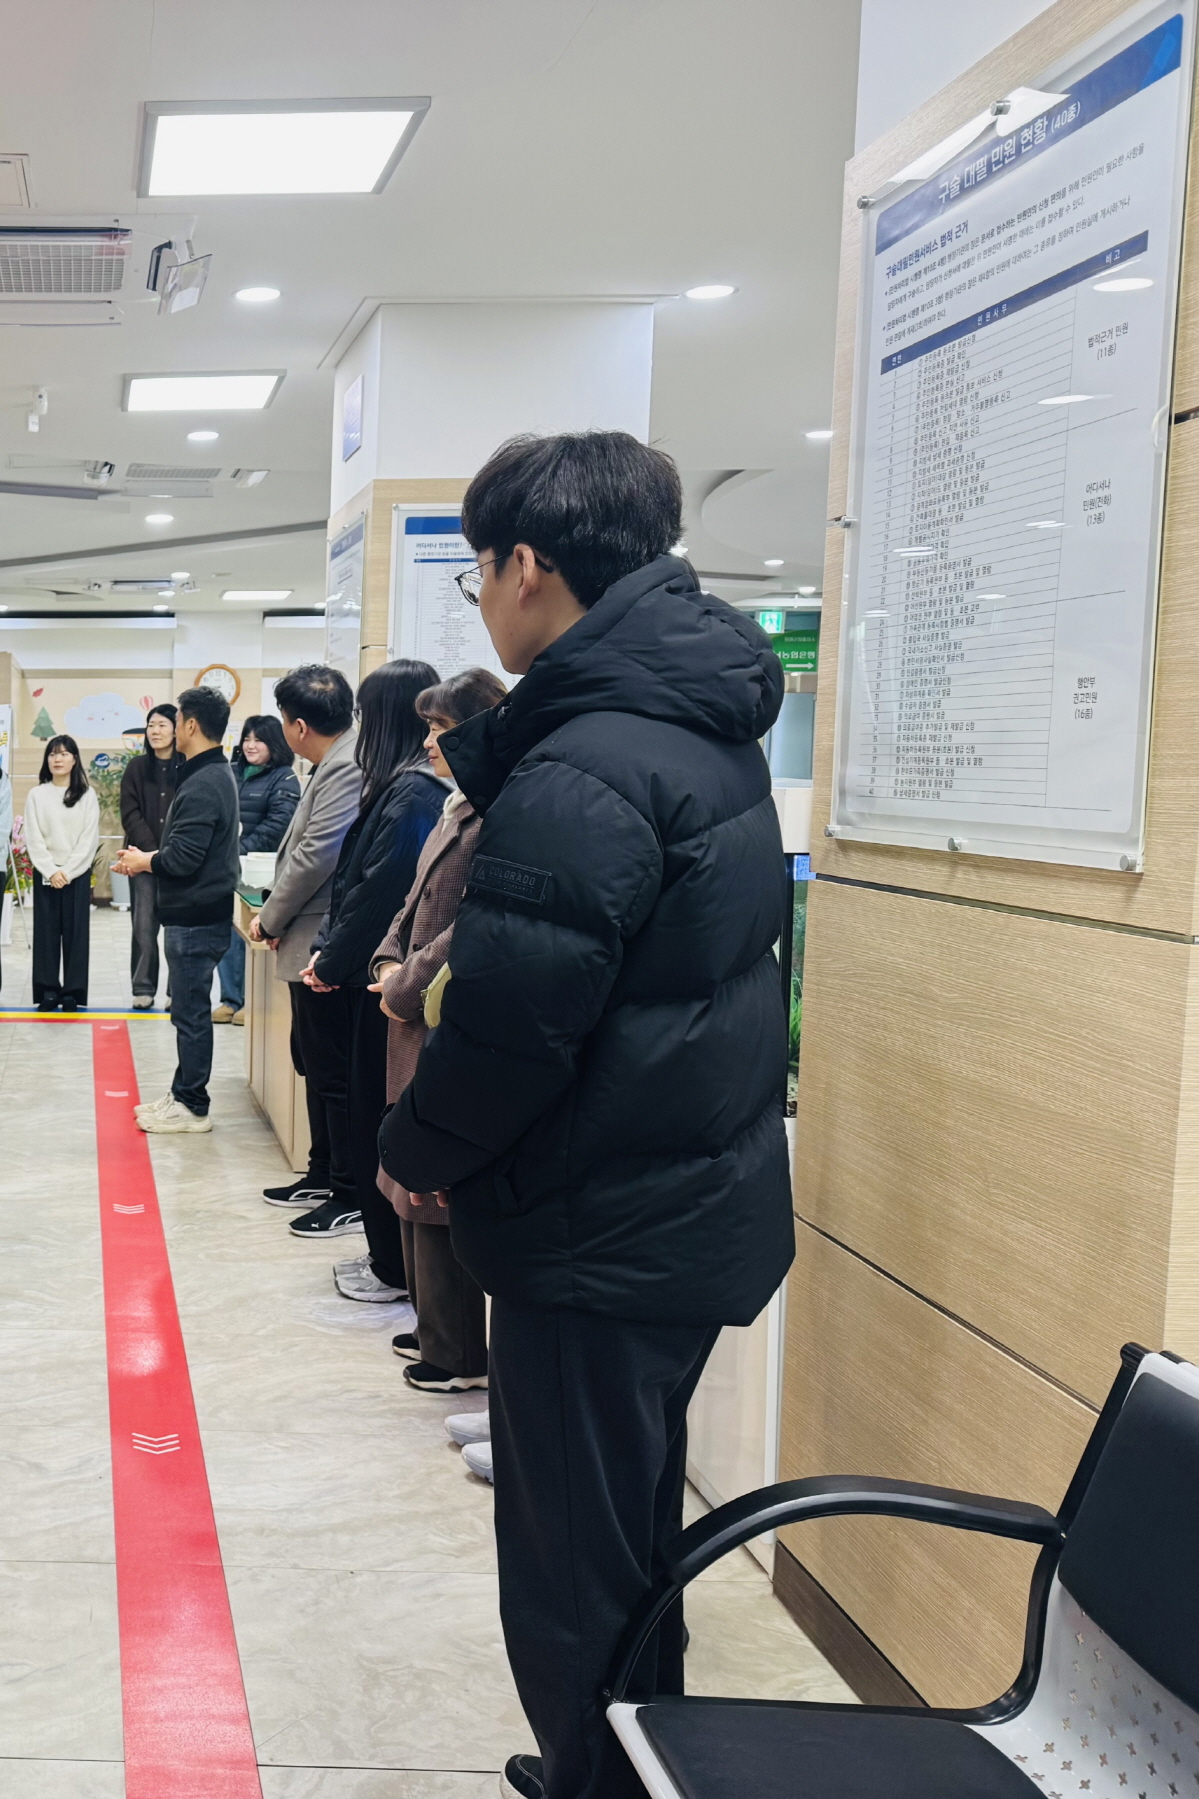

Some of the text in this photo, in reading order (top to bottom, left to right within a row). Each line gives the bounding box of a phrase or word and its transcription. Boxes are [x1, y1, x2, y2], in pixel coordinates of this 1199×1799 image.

[938, 100, 1081, 204] 구술 대필 민원 현황 (40종)
[885, 217, 969, 281] 구술대필민원서비스 법적 근거
[1088, 321, 1129, 348] 법적근거 민원
[1097, 342, 1117, 361] (11종)
[1086, 478, 1111, 494] 어디서나
[1073, 692, 1098, 704] 권고민원
[1074, 707, 1094, 720] (16종)
[489, 866, 536, 886] COLORADO
